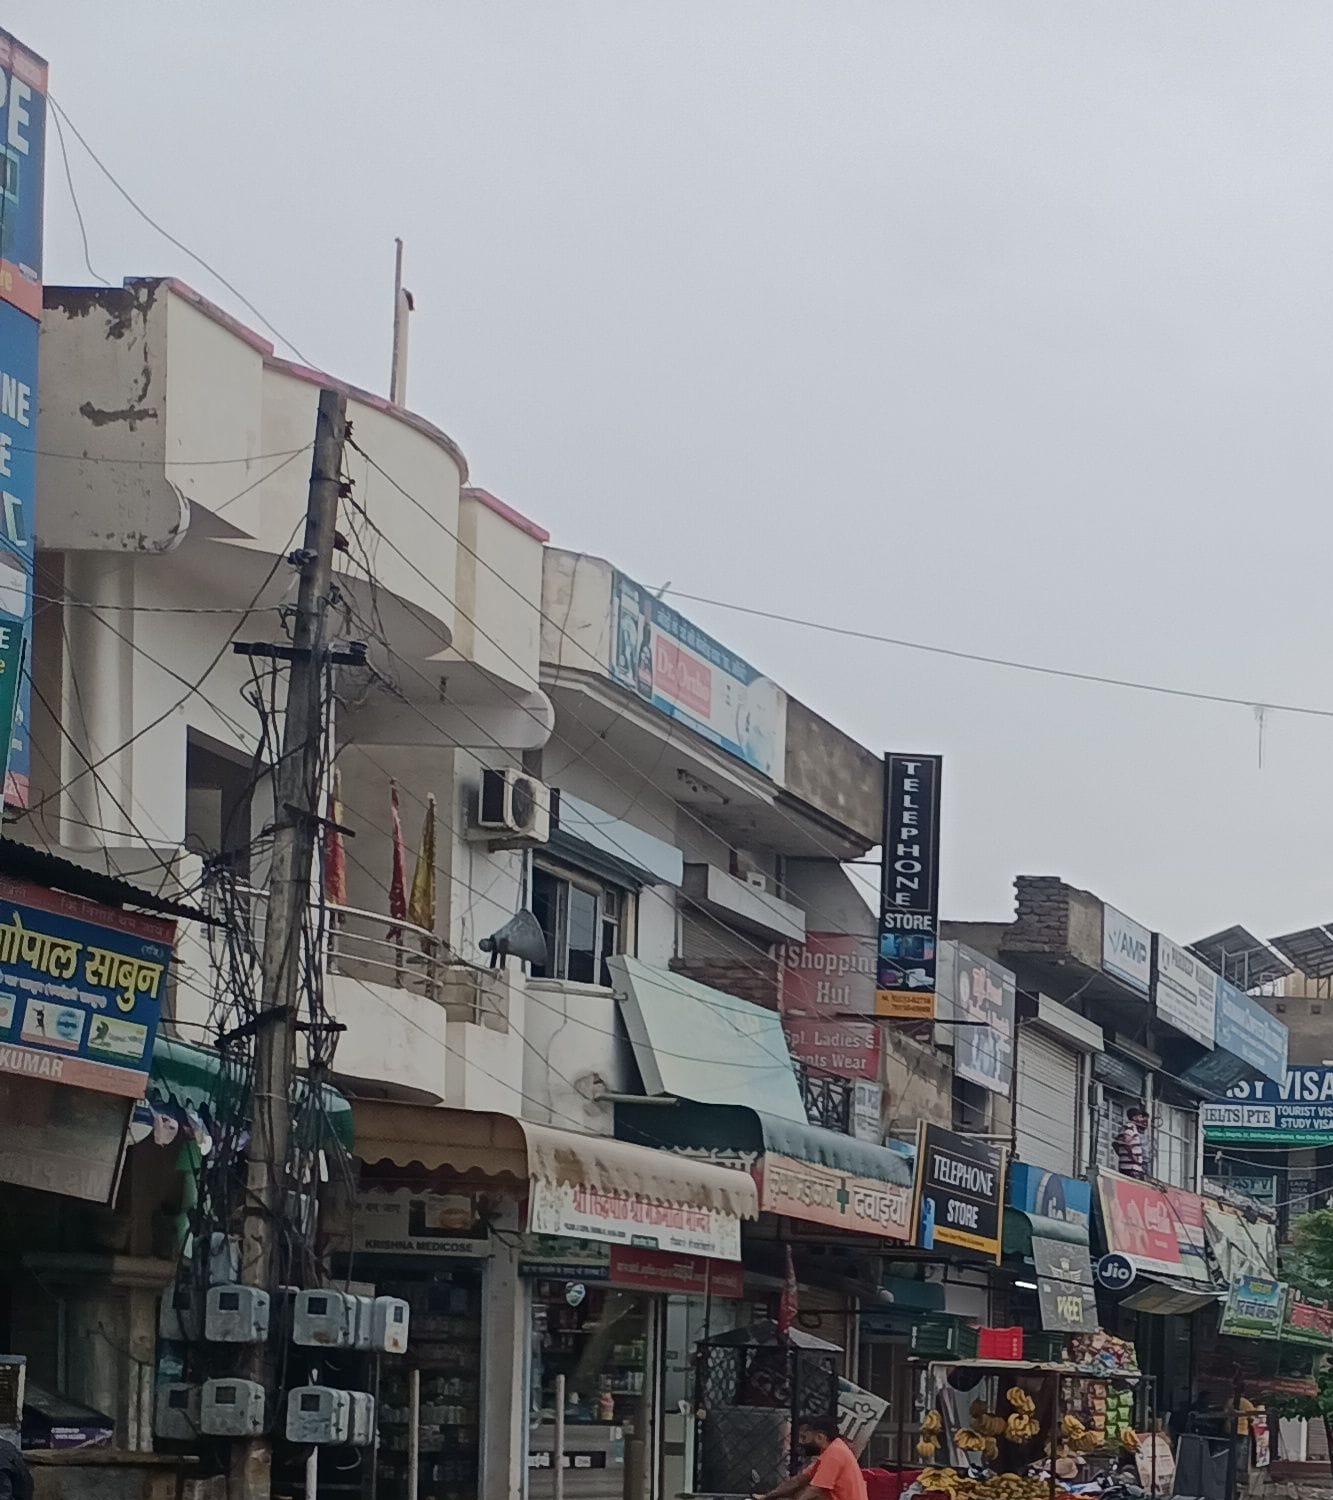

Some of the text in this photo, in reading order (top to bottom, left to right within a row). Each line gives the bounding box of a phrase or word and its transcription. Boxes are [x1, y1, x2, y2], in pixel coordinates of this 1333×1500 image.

[894, 761, 922, 907] TELEPHONE
[884, 912, 933, 931] STORE
[787, 945, 877, 979] Shoppin
[84, 944, 165, 1013] साबुन
[816, 981, 851, 1006] Hut
[814, 1031, 863, 1049] Ladies
[831, 1053, 867, 1071] Wear
[1205, 1108, 1241, 1124] IELTS
[1247, 1109, 1271, 1124] PTE
[1276, 1105, 1316, 1118] TOURIST
[1280, 1117, 1311, 1129] STUDY
[933, 1154, 994, 1197] TELEPHONE
[946, 1198, 980, 1229] STORE
[365, 1239, 473, 1253] KRISHNA MEDICOSE
[1101, 1262, 1130, 1280] Jio
